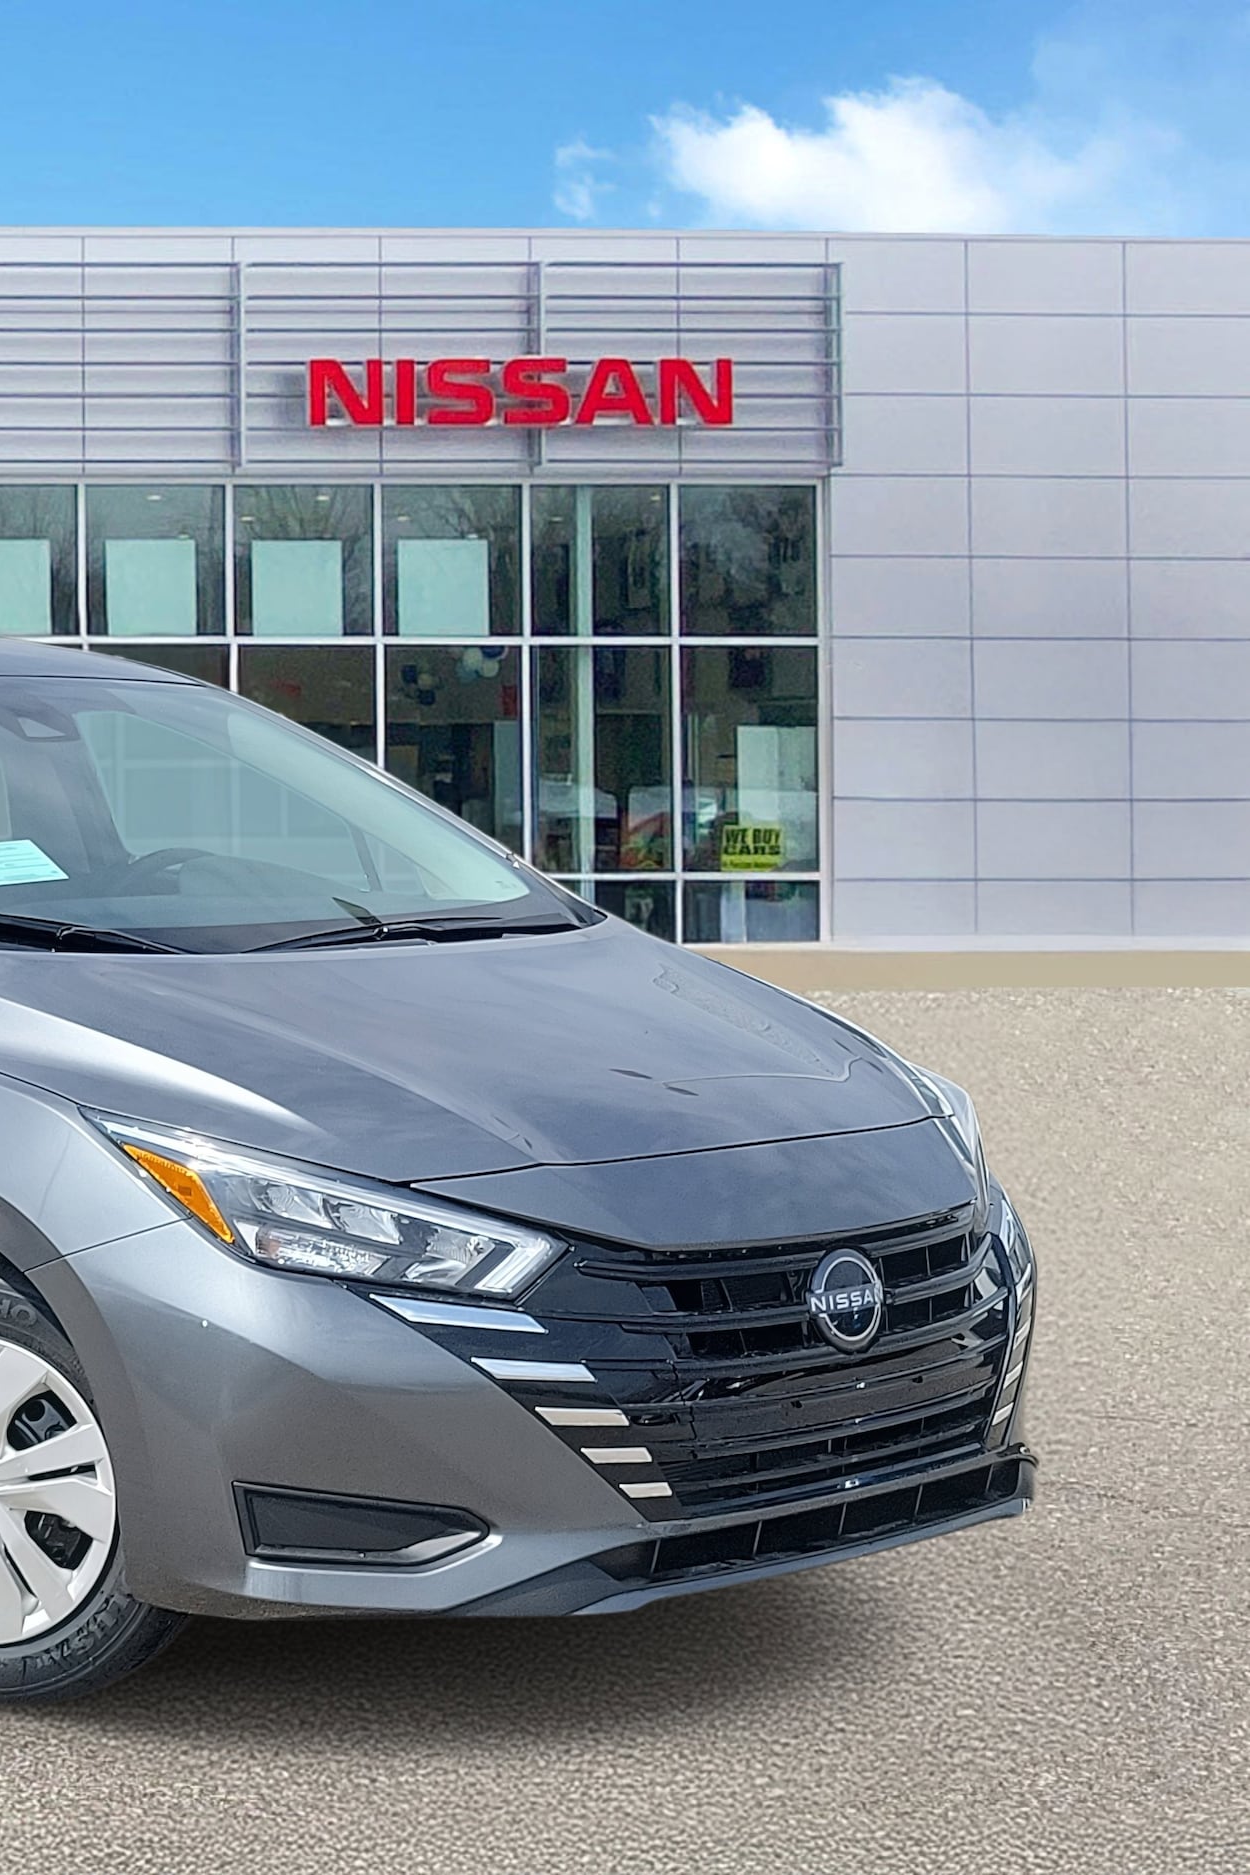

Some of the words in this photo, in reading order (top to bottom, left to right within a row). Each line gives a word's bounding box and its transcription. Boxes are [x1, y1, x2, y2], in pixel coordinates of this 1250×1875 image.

[307, 357, 734, 427] NISSAN
[752, 828, 780, 844] BUY
[723, 844, 781, 855] CARS
